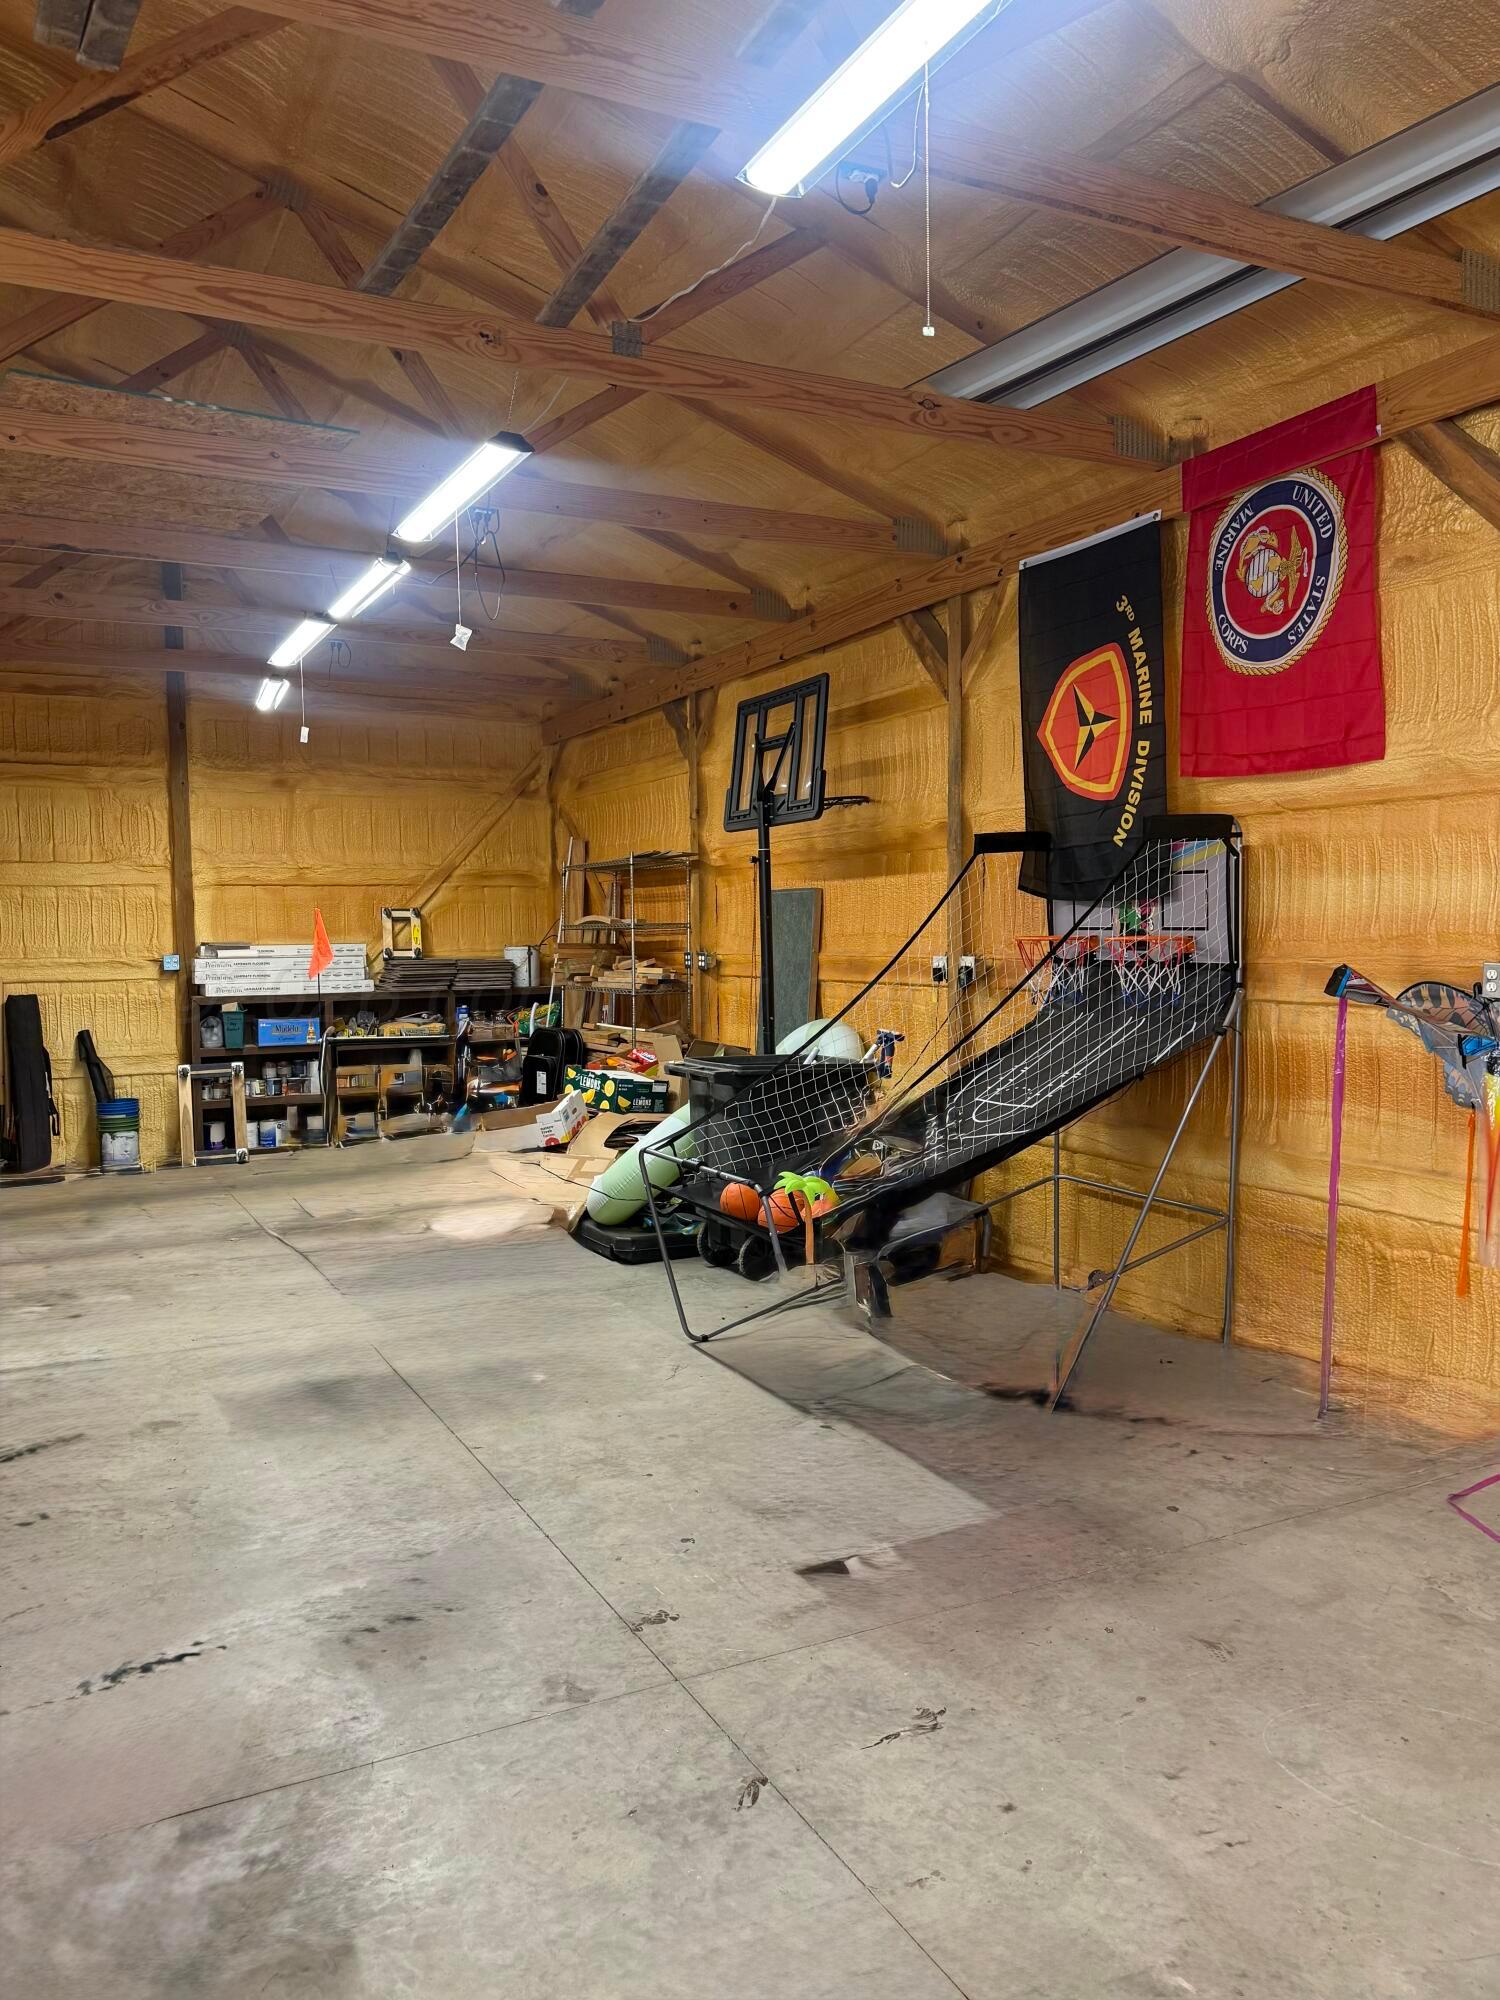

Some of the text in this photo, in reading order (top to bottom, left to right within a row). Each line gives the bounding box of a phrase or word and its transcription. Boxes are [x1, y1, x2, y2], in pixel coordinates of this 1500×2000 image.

[1214, 503, 1254, 654] MARINE CORPS
[1288, 485, 1333, 645] UNITED STATES
[1113, 594, 1153, 848] 3RD MARINE DIVISION
[580, 1075, 602, 1091] LEMONS
[632, 1098, 652, 1106] LEMONS
